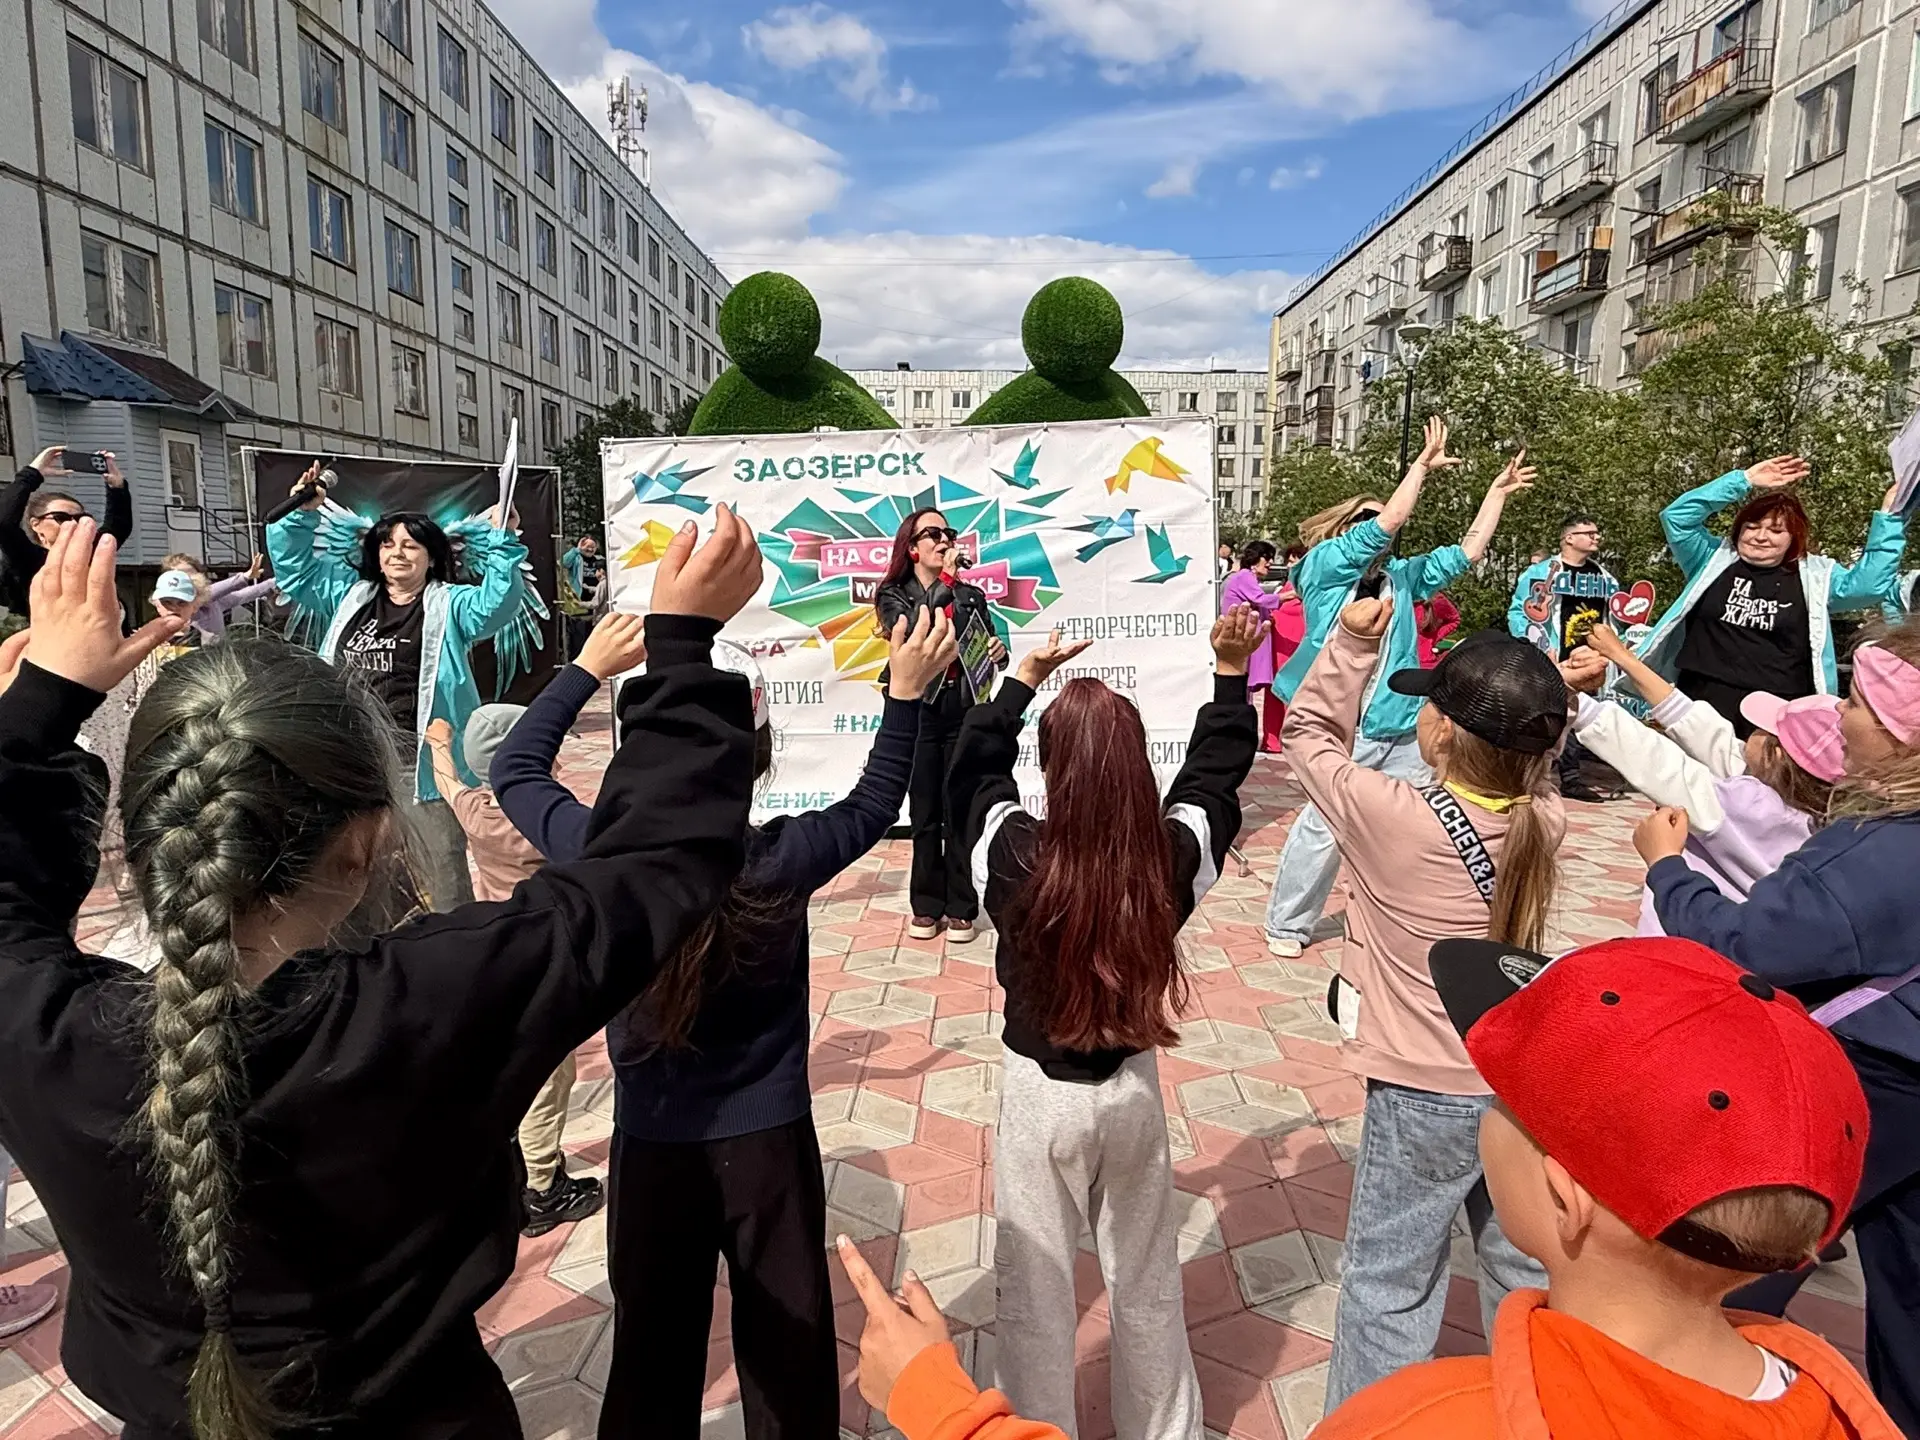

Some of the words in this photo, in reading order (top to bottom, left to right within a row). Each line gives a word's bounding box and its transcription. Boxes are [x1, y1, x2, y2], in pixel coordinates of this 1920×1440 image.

[734, 452, 927, 482] ЗАОЗЕРСК
[827, 548, 862, 567] НА
[1553, 570, 1620, 598] ДЕНЬ
[1055, 612, 1197, 641] #ТВОРЧЕСТВО
[1422, 785, 1496, 901] KUCHEN&B
